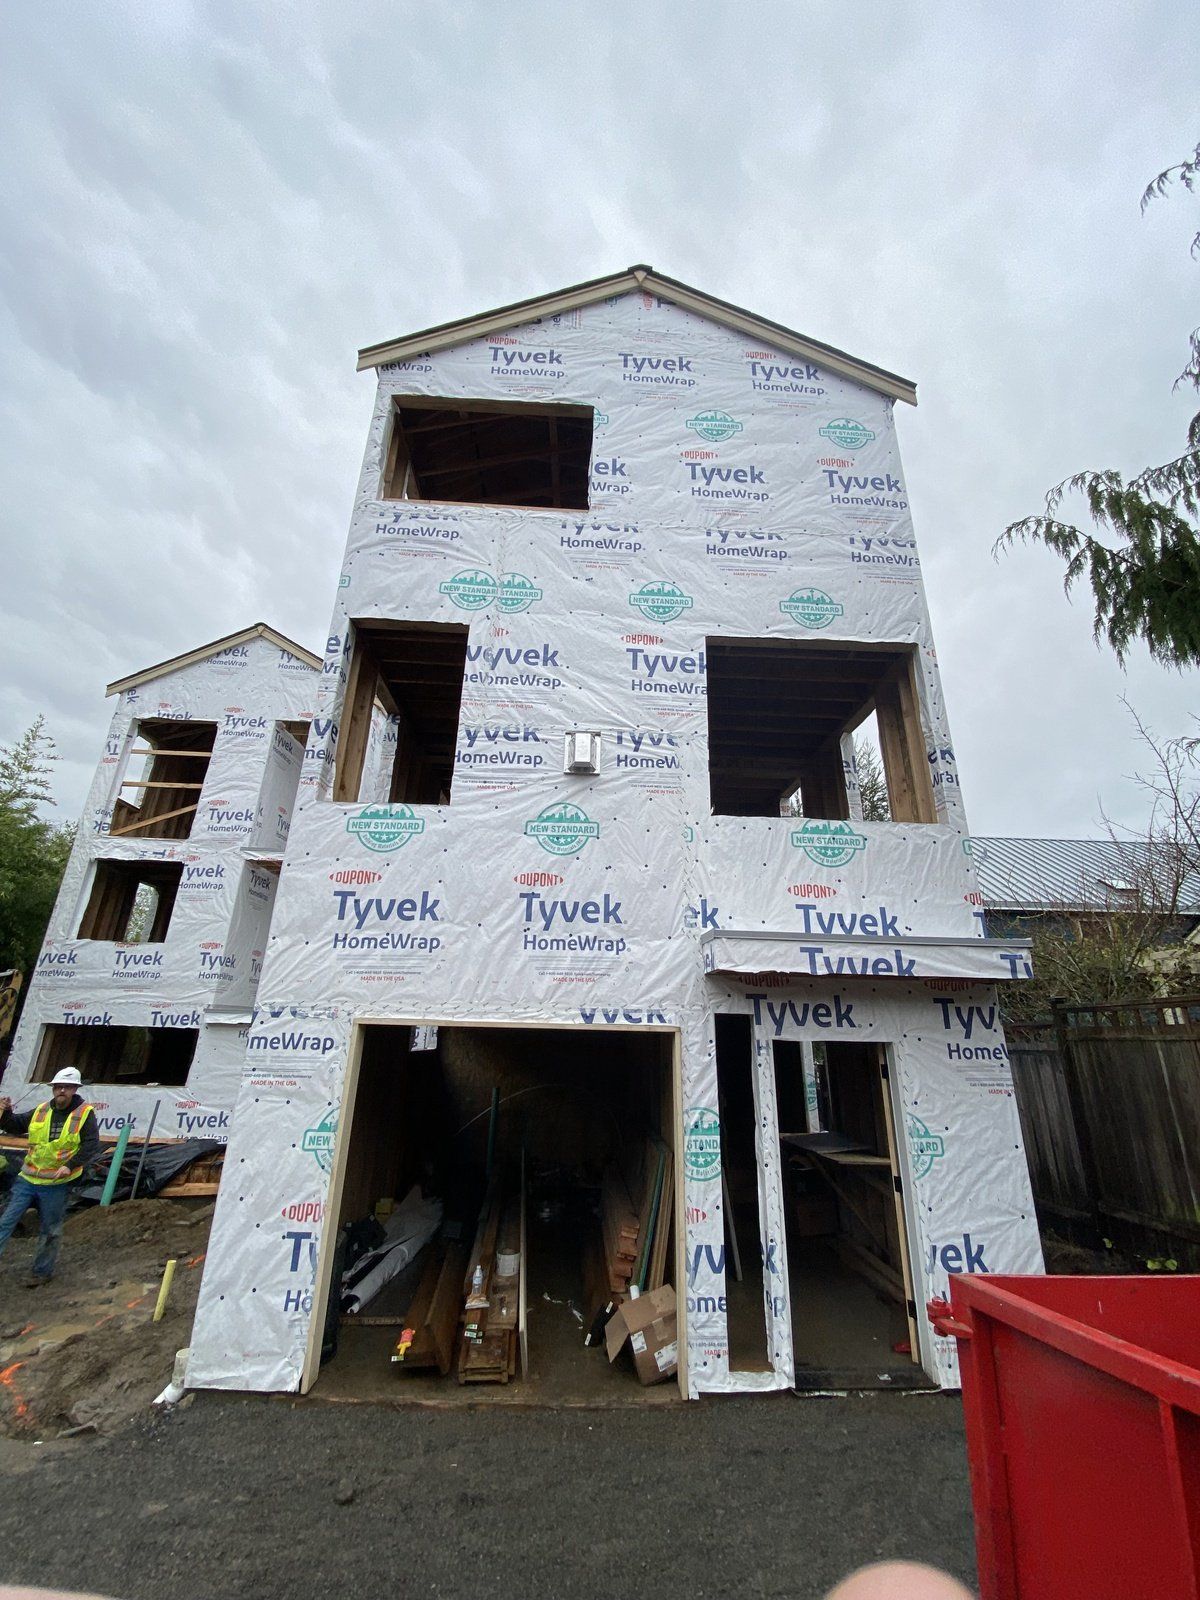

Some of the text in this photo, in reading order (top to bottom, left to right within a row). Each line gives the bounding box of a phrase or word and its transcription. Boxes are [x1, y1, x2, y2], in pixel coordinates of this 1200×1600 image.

[489, 347, 563, 365] Tyvek
[618, 353, 693, 373] Tyvek
[490, 366, 565, 379] HomeWrap
[751, 361, 820, 381] Tyvek
[623, 373, 696, 387] HomeWrap
[752, 381, 825, 396] HomeWrap
[705, 422, 740, 430] STANDARD
[684, 451, 715, 460] DUPONT
[820, 458, 851, 468] DUPONT
[685, 462, 766, 486] Tyvek
[823, 470, 901, 493] Tyvek
[691, 487, 770, 502] HomeWrap
[831, 494, 908, 510] HomeWrap
[375, 523, 460, 540] HomeWrap
[560, 537, 642, 552] HomeWrap
[706, 544, 788, 560] HomeWrap
[651, 598, 690, 606] STANDARD
[801, 605, 840, 613] STANDARD
[626, 634, 660, 646] DUPONT
[206, 659, 247, 667] HomeWrap
[225, 714, 267, 729] Tyvek
[223, 729, 265, 739] HomeWrap
[208, 808, 254, 823] Tyvek
[207, 824, 253, 833] HomeWrap
[351, 821, 420, 830] NEW STANDARD
[530, 825, 595, 834] NEW STANDARD
[796, 836, 861, 847] NEW STANDARD
[250, 869, 271, 890] Tyvek
[335, 870, 377, 885] DUPONT
[519, 872, 560, 887] DUPONT
[794, 884, 832, 899] DUPONT
[333, 890, 440, 930] Tyvek
[519, 892, 623, 931] Tyvek
[795, 904, 901, 937] Tyvek
[333, 933, 441, 953] HomeWrap
[523, 934, 627, 955] HomeWrap
[114, 951, 163, 969] Tyvek
[200, 952, 236, 970] Tyvek
[800, 947, 917, 976] Tyvek
[112, 970, 161, 980] HomeWrap
[150, 1011, 201, 1028] Tyvek
[746, 993, 856, 1036] Tyvek
[933, 997, 1000, 1040] Tyv
[246, 1032, 335, 1055] meWrap
[176, 1111, 229, 1133] Tyvek
[308, 1135, 332, 1146] NEW
